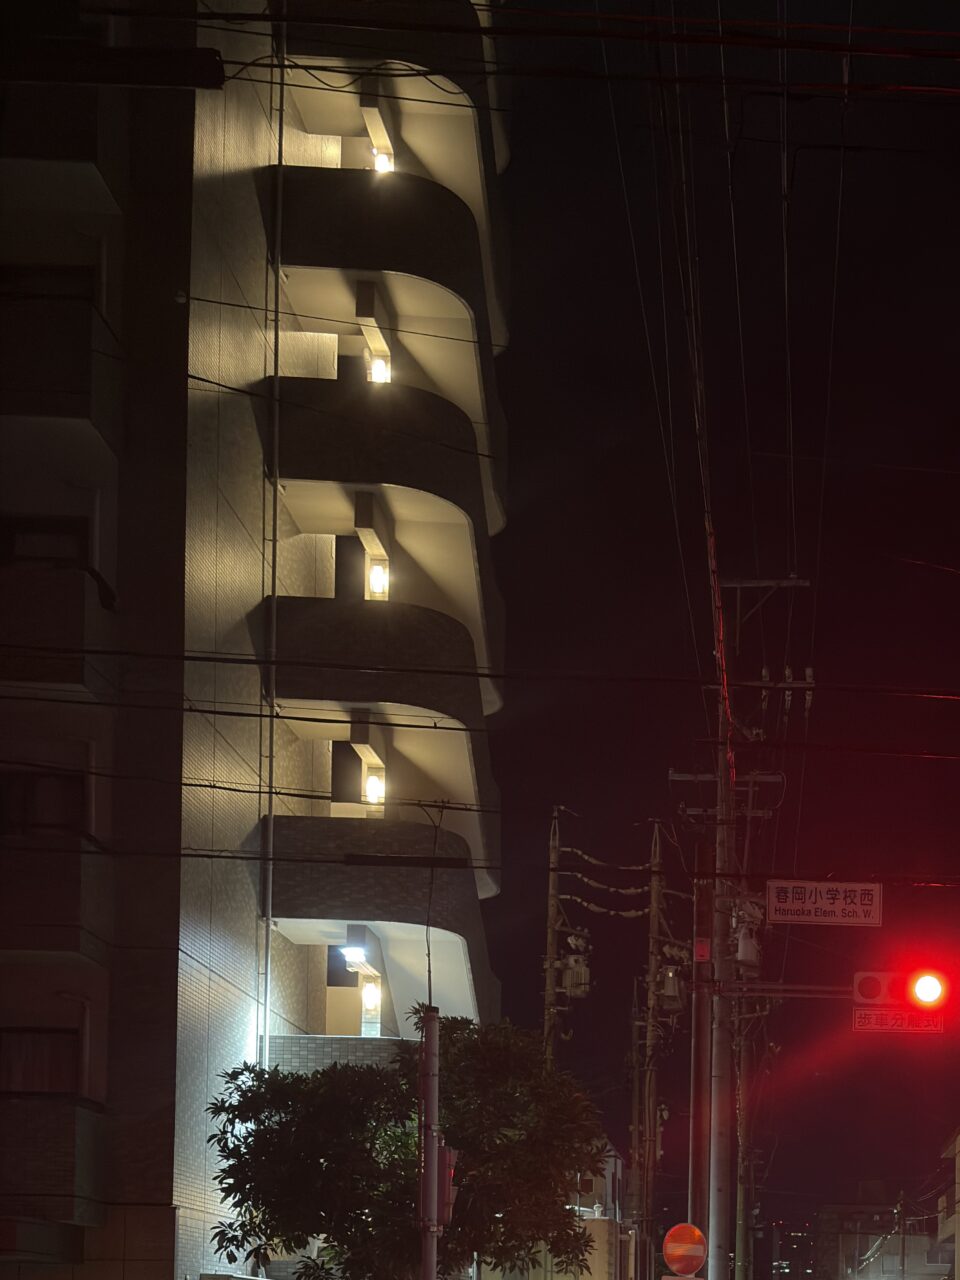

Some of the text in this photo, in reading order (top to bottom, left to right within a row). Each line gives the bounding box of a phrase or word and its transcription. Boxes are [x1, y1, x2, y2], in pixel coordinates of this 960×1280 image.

[775, 886, 874, 906] 春岡小学校西
[774, 907, 811, 917] Haruoka
[814, 907, 838, 918] Elem.
[863, 908, 874, 919] W.
